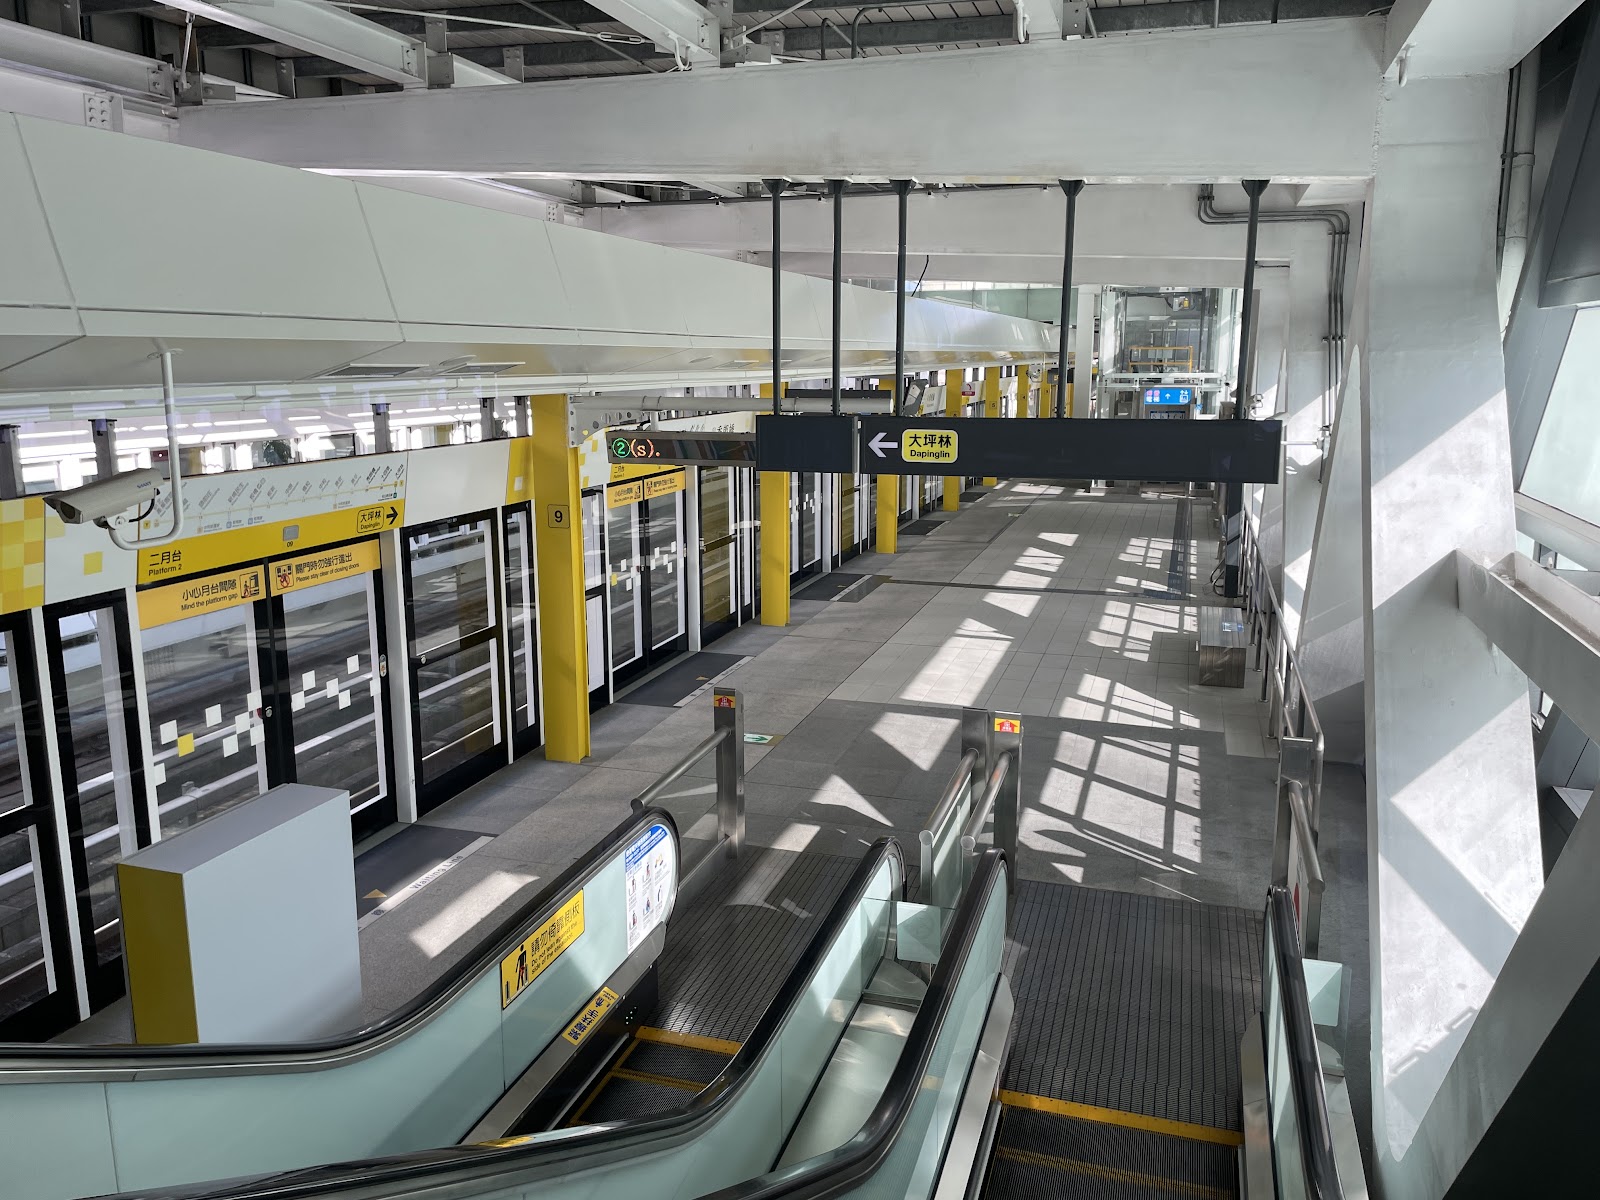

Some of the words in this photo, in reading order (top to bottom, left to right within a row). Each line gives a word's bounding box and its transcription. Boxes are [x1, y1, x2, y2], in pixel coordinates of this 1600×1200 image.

[908, 434, 952, 448] 大坪林
[910, 449, 950, 459] Dapinglin
[360, 509, 382, 523] 大坪林
[554, 510, 563, 523] 9
[360, 521, 381, 531] Dapinglin
[149, 549, 182, 567] 二月台
[148, 566, 177, 577] Platform
[177, 563, 183, 571] 2
[295, 574, 311, 583] Please
[310, 573, 319, 581] stay
[319, 569, 330, 578] clear
[334, 565, 349, 575] closing
[348, 562, 360, 571] doors
[182, 578, 237, 602] 小心月台間隙
[181, 601, 196, 612] Mind
[195, 599, 205, 608] the
[205, 594, 228, 608] platform
[228, 592, 239, 602] gap
[442, 855, 464, 868] Line
[531, 957, 538, 967] Do
[538, 949, 546, 961] not
